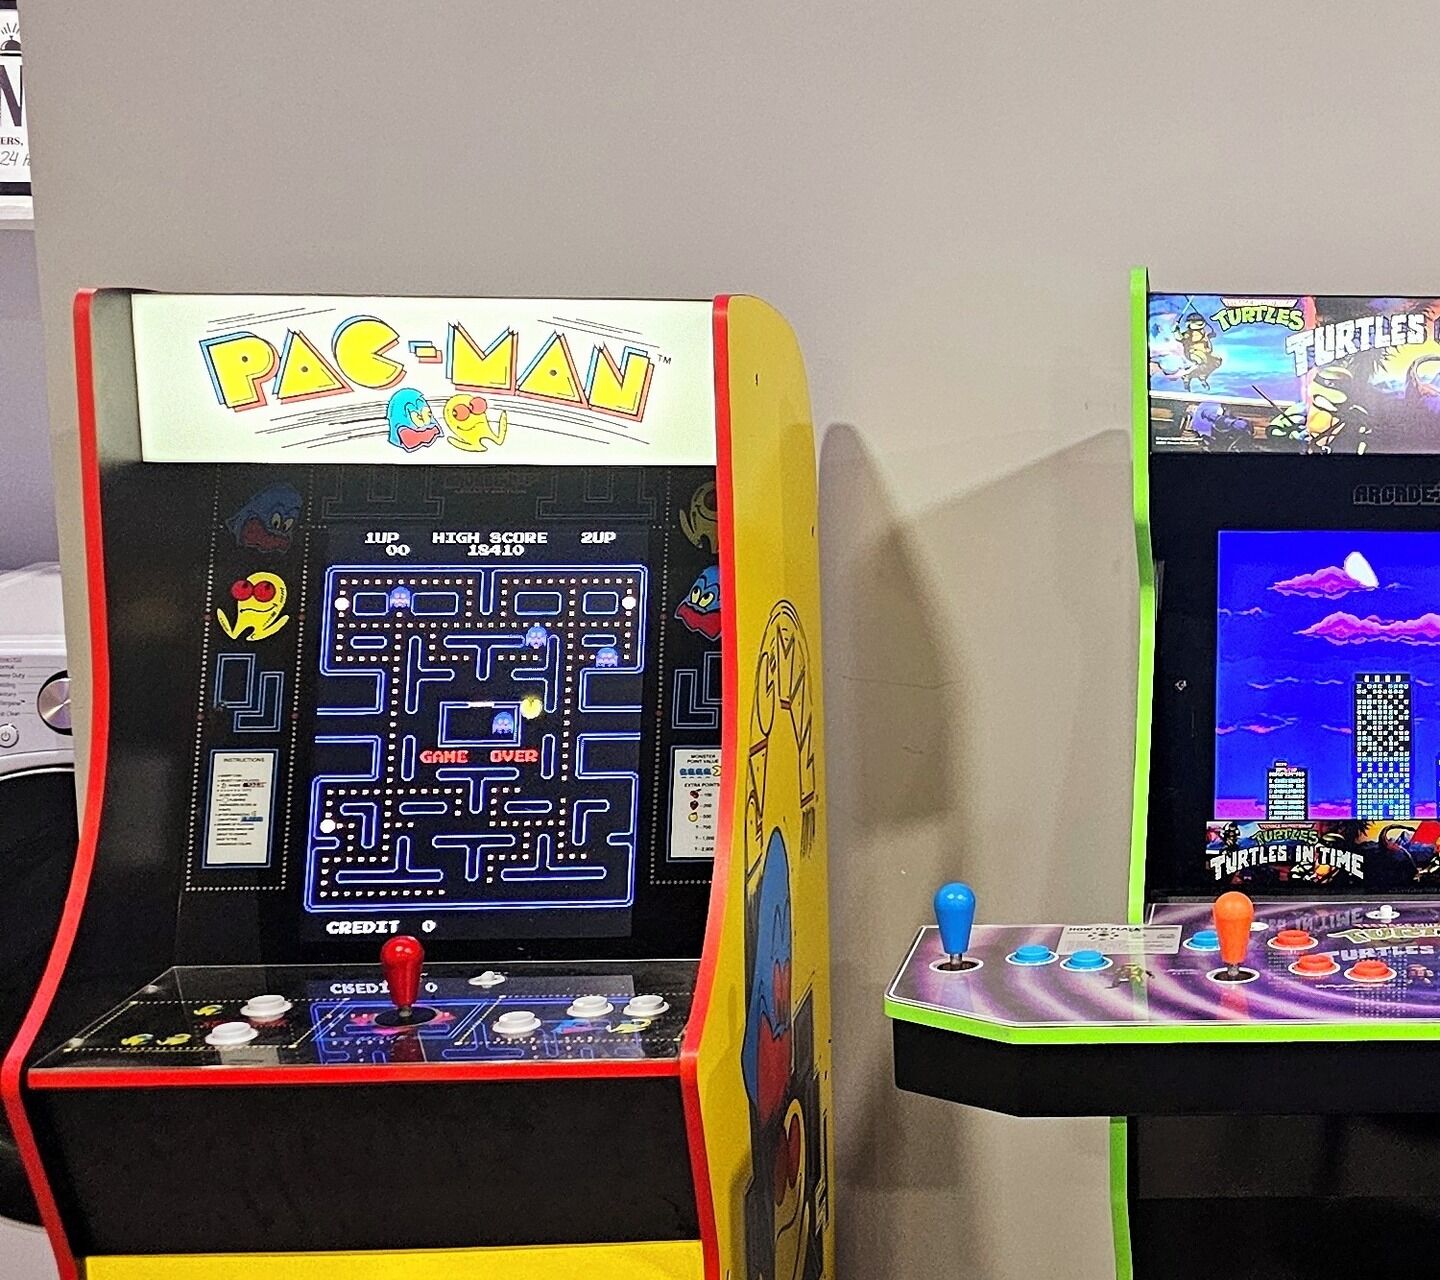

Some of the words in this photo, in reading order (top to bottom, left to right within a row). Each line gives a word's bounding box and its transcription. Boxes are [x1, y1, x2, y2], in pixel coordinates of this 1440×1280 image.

[0, 136, 24, 147] ERS,
[1210, 305, 1305, 332] TURTLES
[1286, 314, 1427, 377] TURTLES
[199, 315, 655, 423] PAC-MAN
[365, 532, 400, 544] 1UP
[432, 532, 480, 544] HIGH
[489, 532, 548, 544] SCORE
[580, 531, 617, 544] 2UP
[385, 544, 411, 556] 00
[420, 750, 469, 764] GAME
[490, 749, 539, 763] OVER
[1252, 828, 1319, 845] TURTLES
[1210, 845, 1287, 881] TURTLES
[1295, 845, 1314, 863] IN
[1319, 847, 1364, 880] TIME
[326, 920, 400, 934] CREDIT
[1323, 945, 1434, 962] TURTLES
